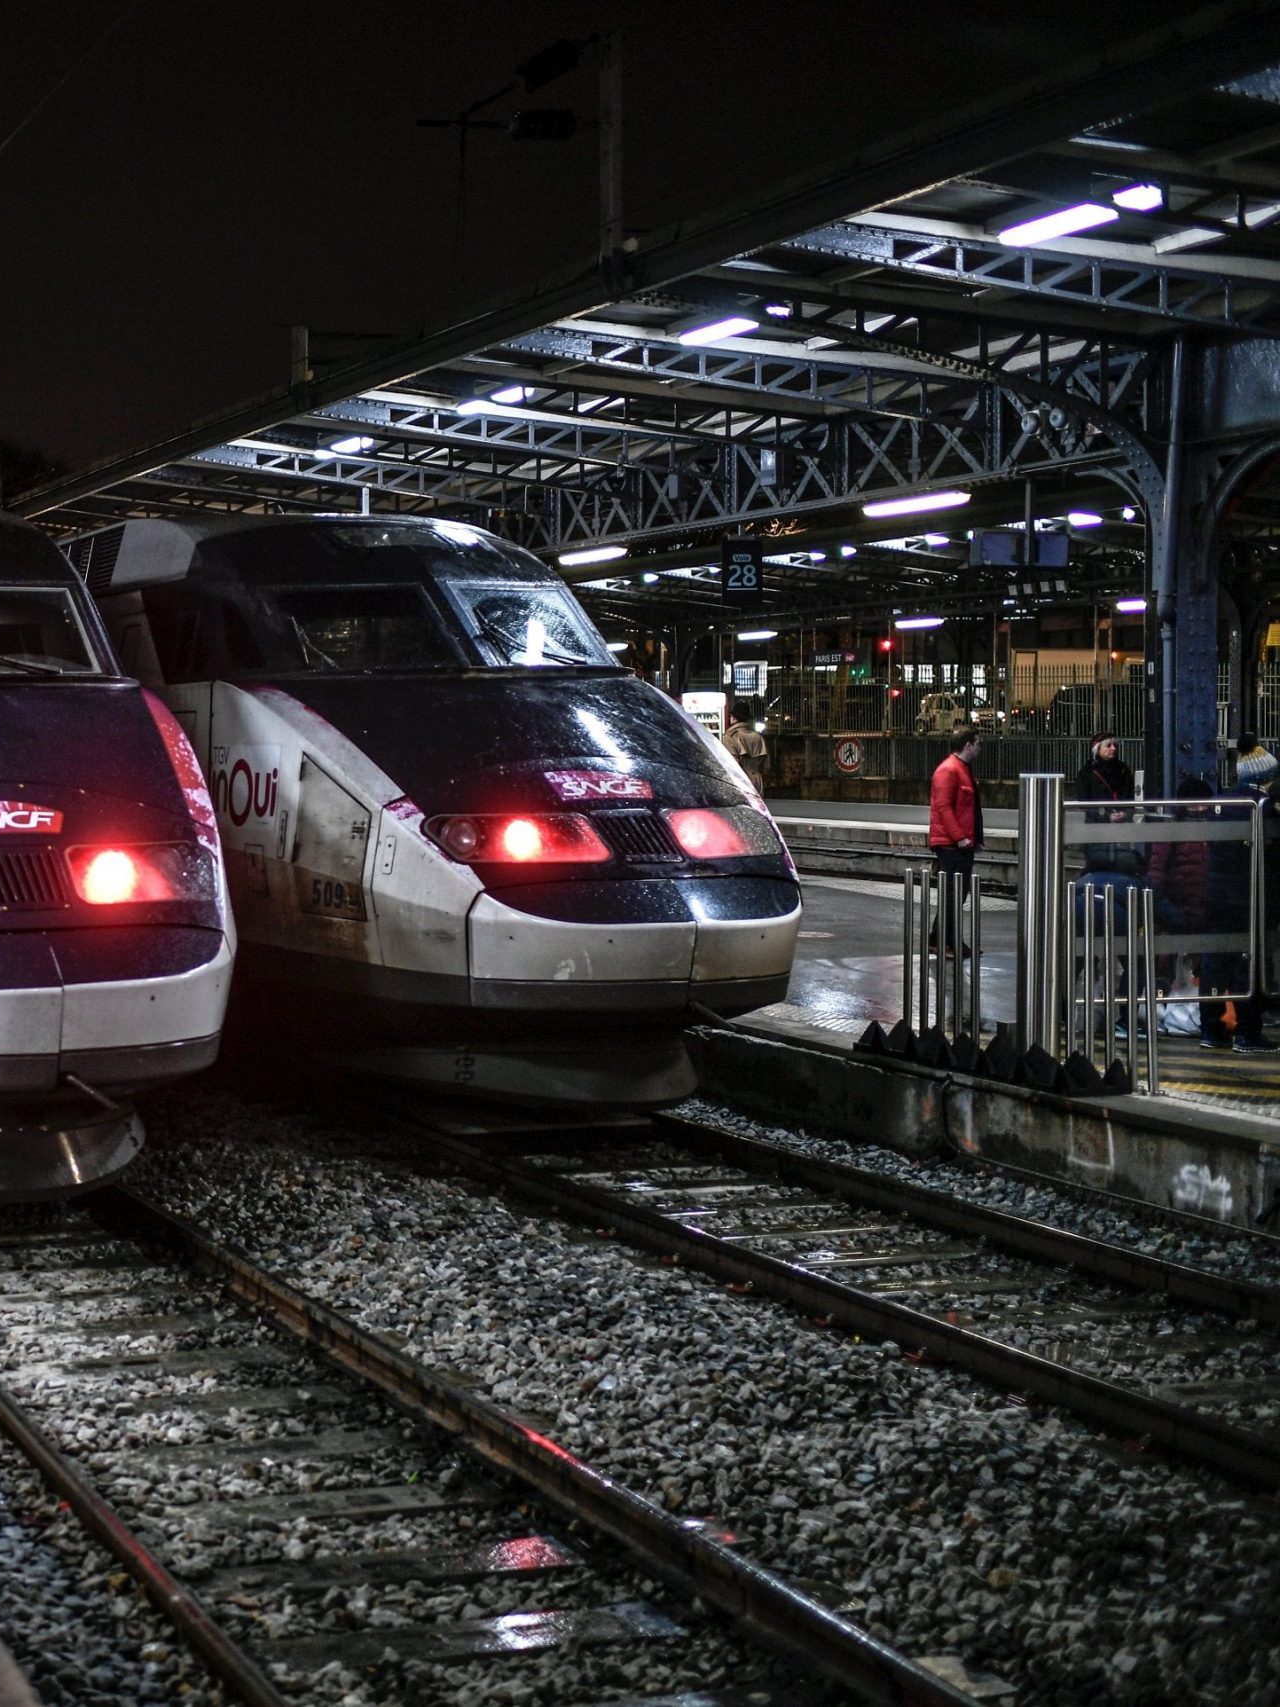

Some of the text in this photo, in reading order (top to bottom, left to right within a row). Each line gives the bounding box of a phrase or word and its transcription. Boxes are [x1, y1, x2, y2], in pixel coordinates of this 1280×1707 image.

[728, 564, 757, 587] 28
[815, 655, 830, 663] PARIS
[831, 653, 842, 663] EST
[213, 745, 231, 765] TGV
[562, 780, 643, 797] SNCF
